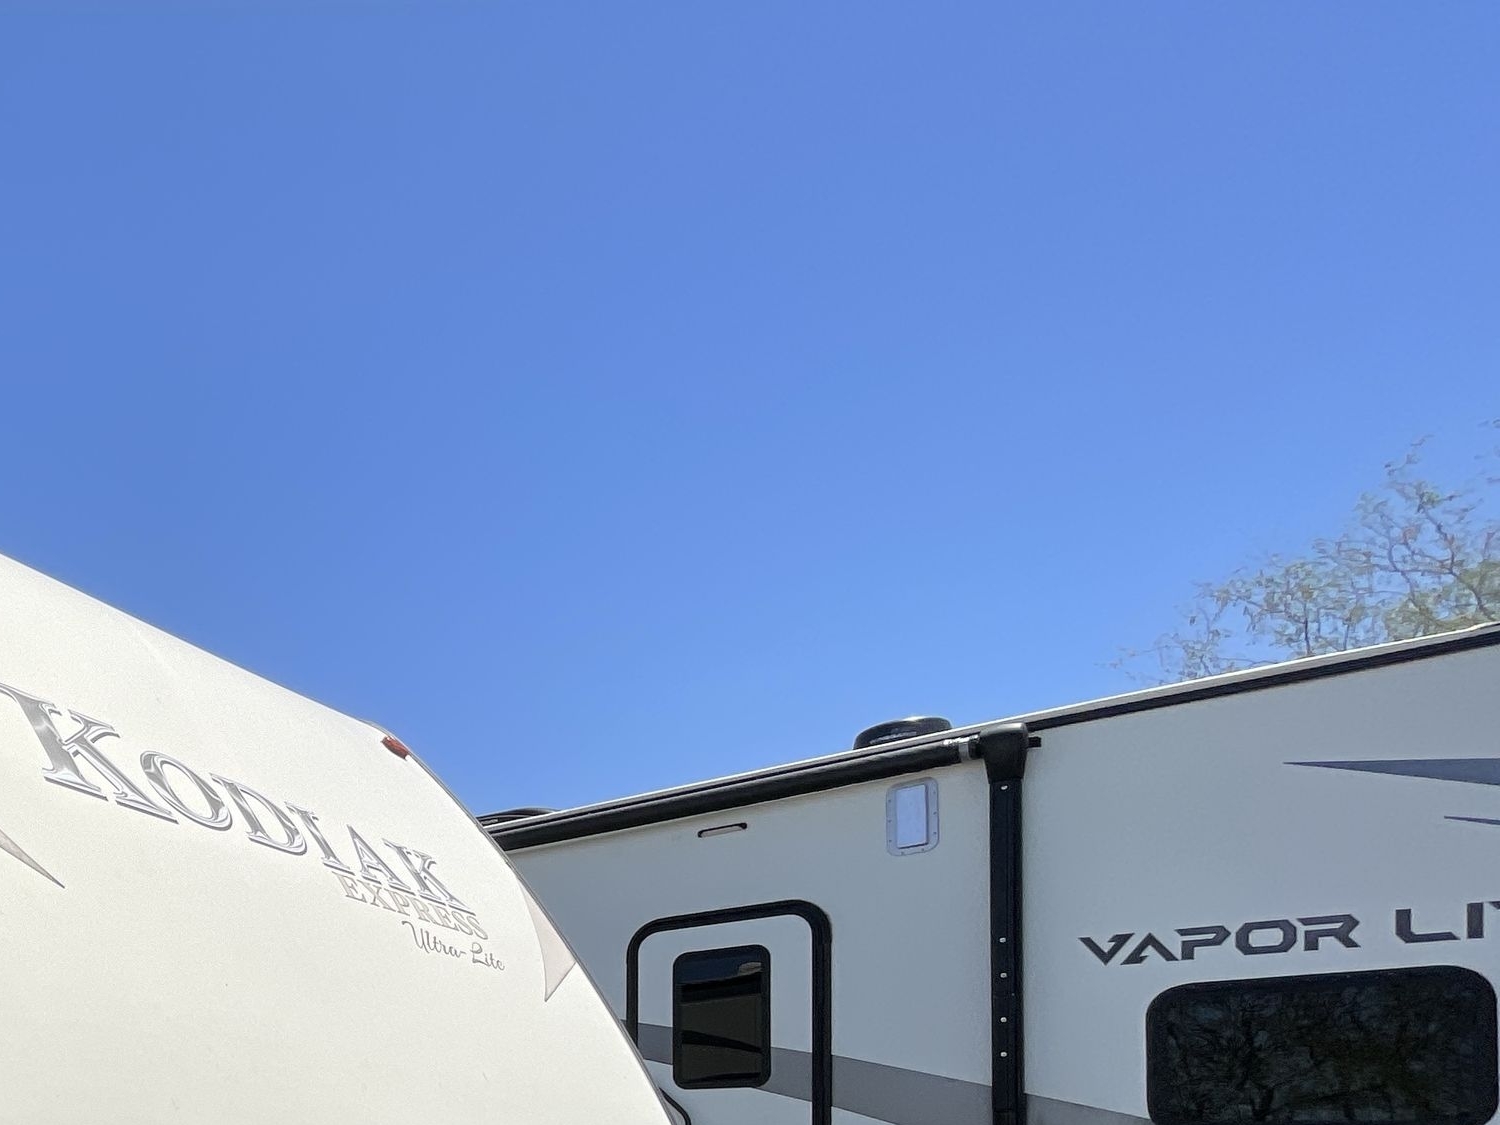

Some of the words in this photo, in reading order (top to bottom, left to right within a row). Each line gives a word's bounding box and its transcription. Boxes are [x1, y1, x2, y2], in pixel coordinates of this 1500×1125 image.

[332, 870, 489, 940] EXPRESS
[1078, 914, 1361, 966] VAPOR
[1395, 900, 1500, 943] LI
